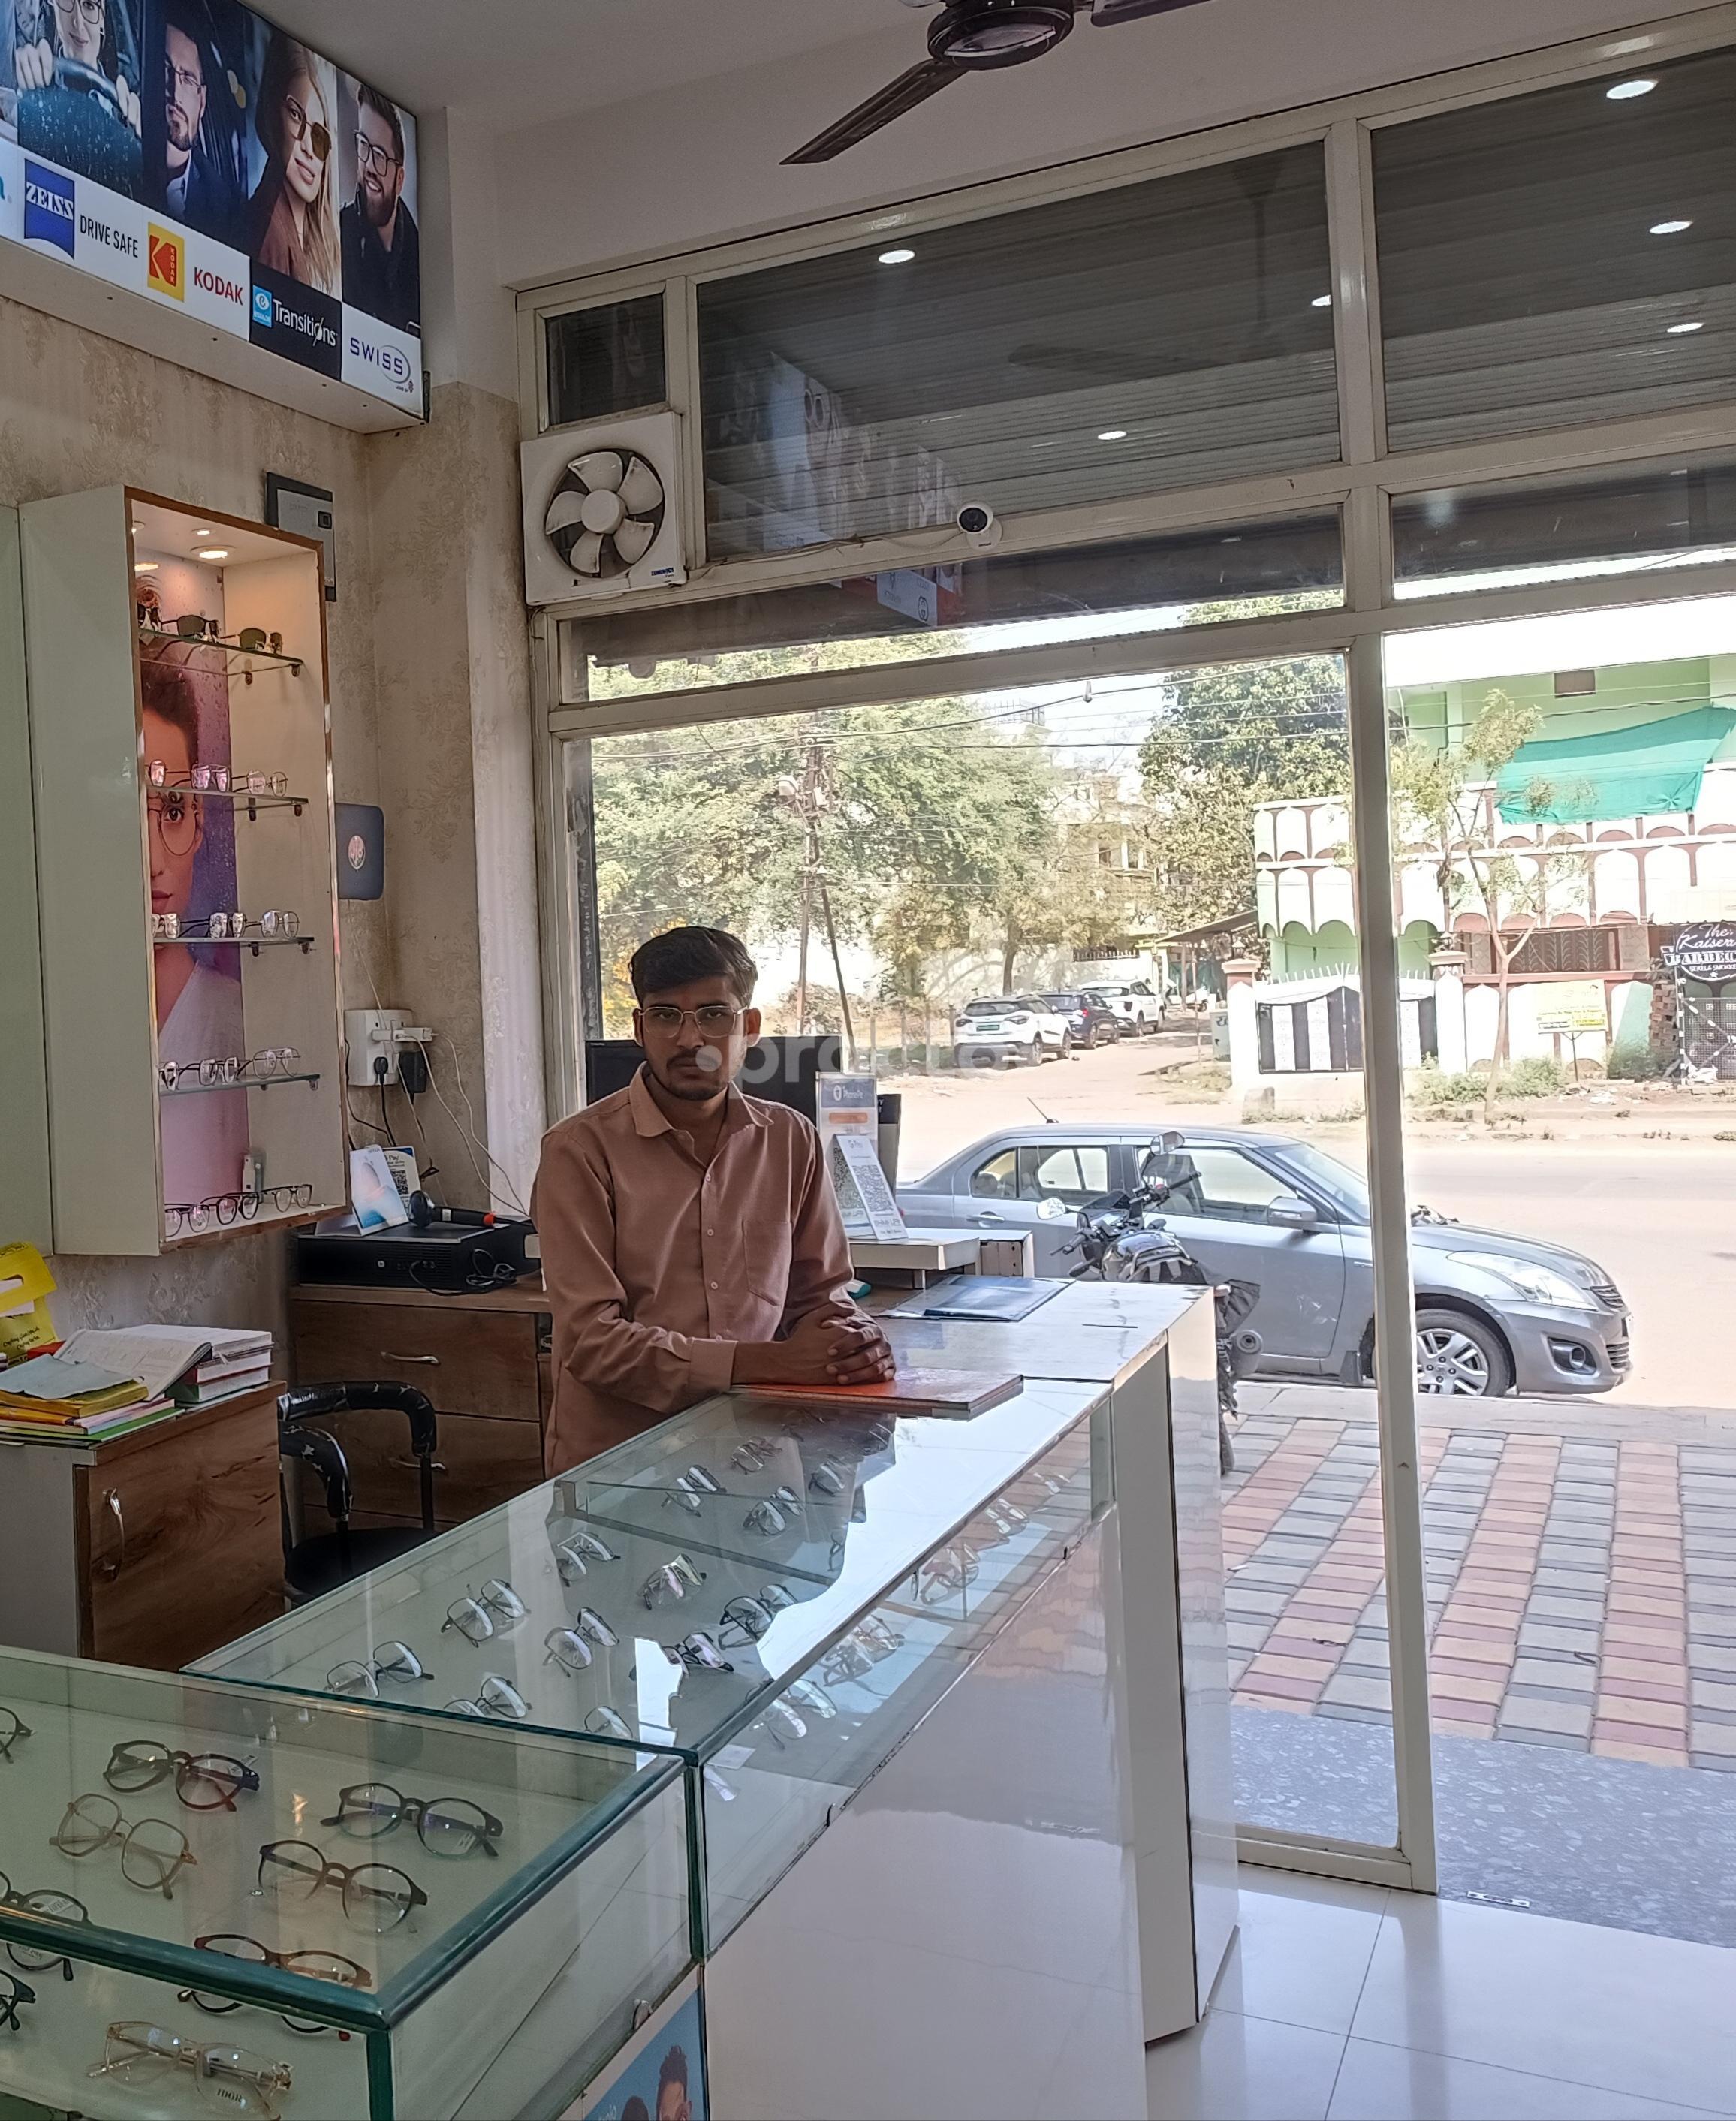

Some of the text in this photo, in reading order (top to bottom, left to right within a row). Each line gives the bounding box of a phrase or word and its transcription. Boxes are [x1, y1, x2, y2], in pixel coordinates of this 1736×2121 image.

[26, 181, 74, 221] ZEISS
[80, 215, 138, 258] DRIVE SAFE
[194, 267, 243, 306] KODAK
[273, 299, 337, 347] Transitions
[350, 337, 403, 375] SWISS
